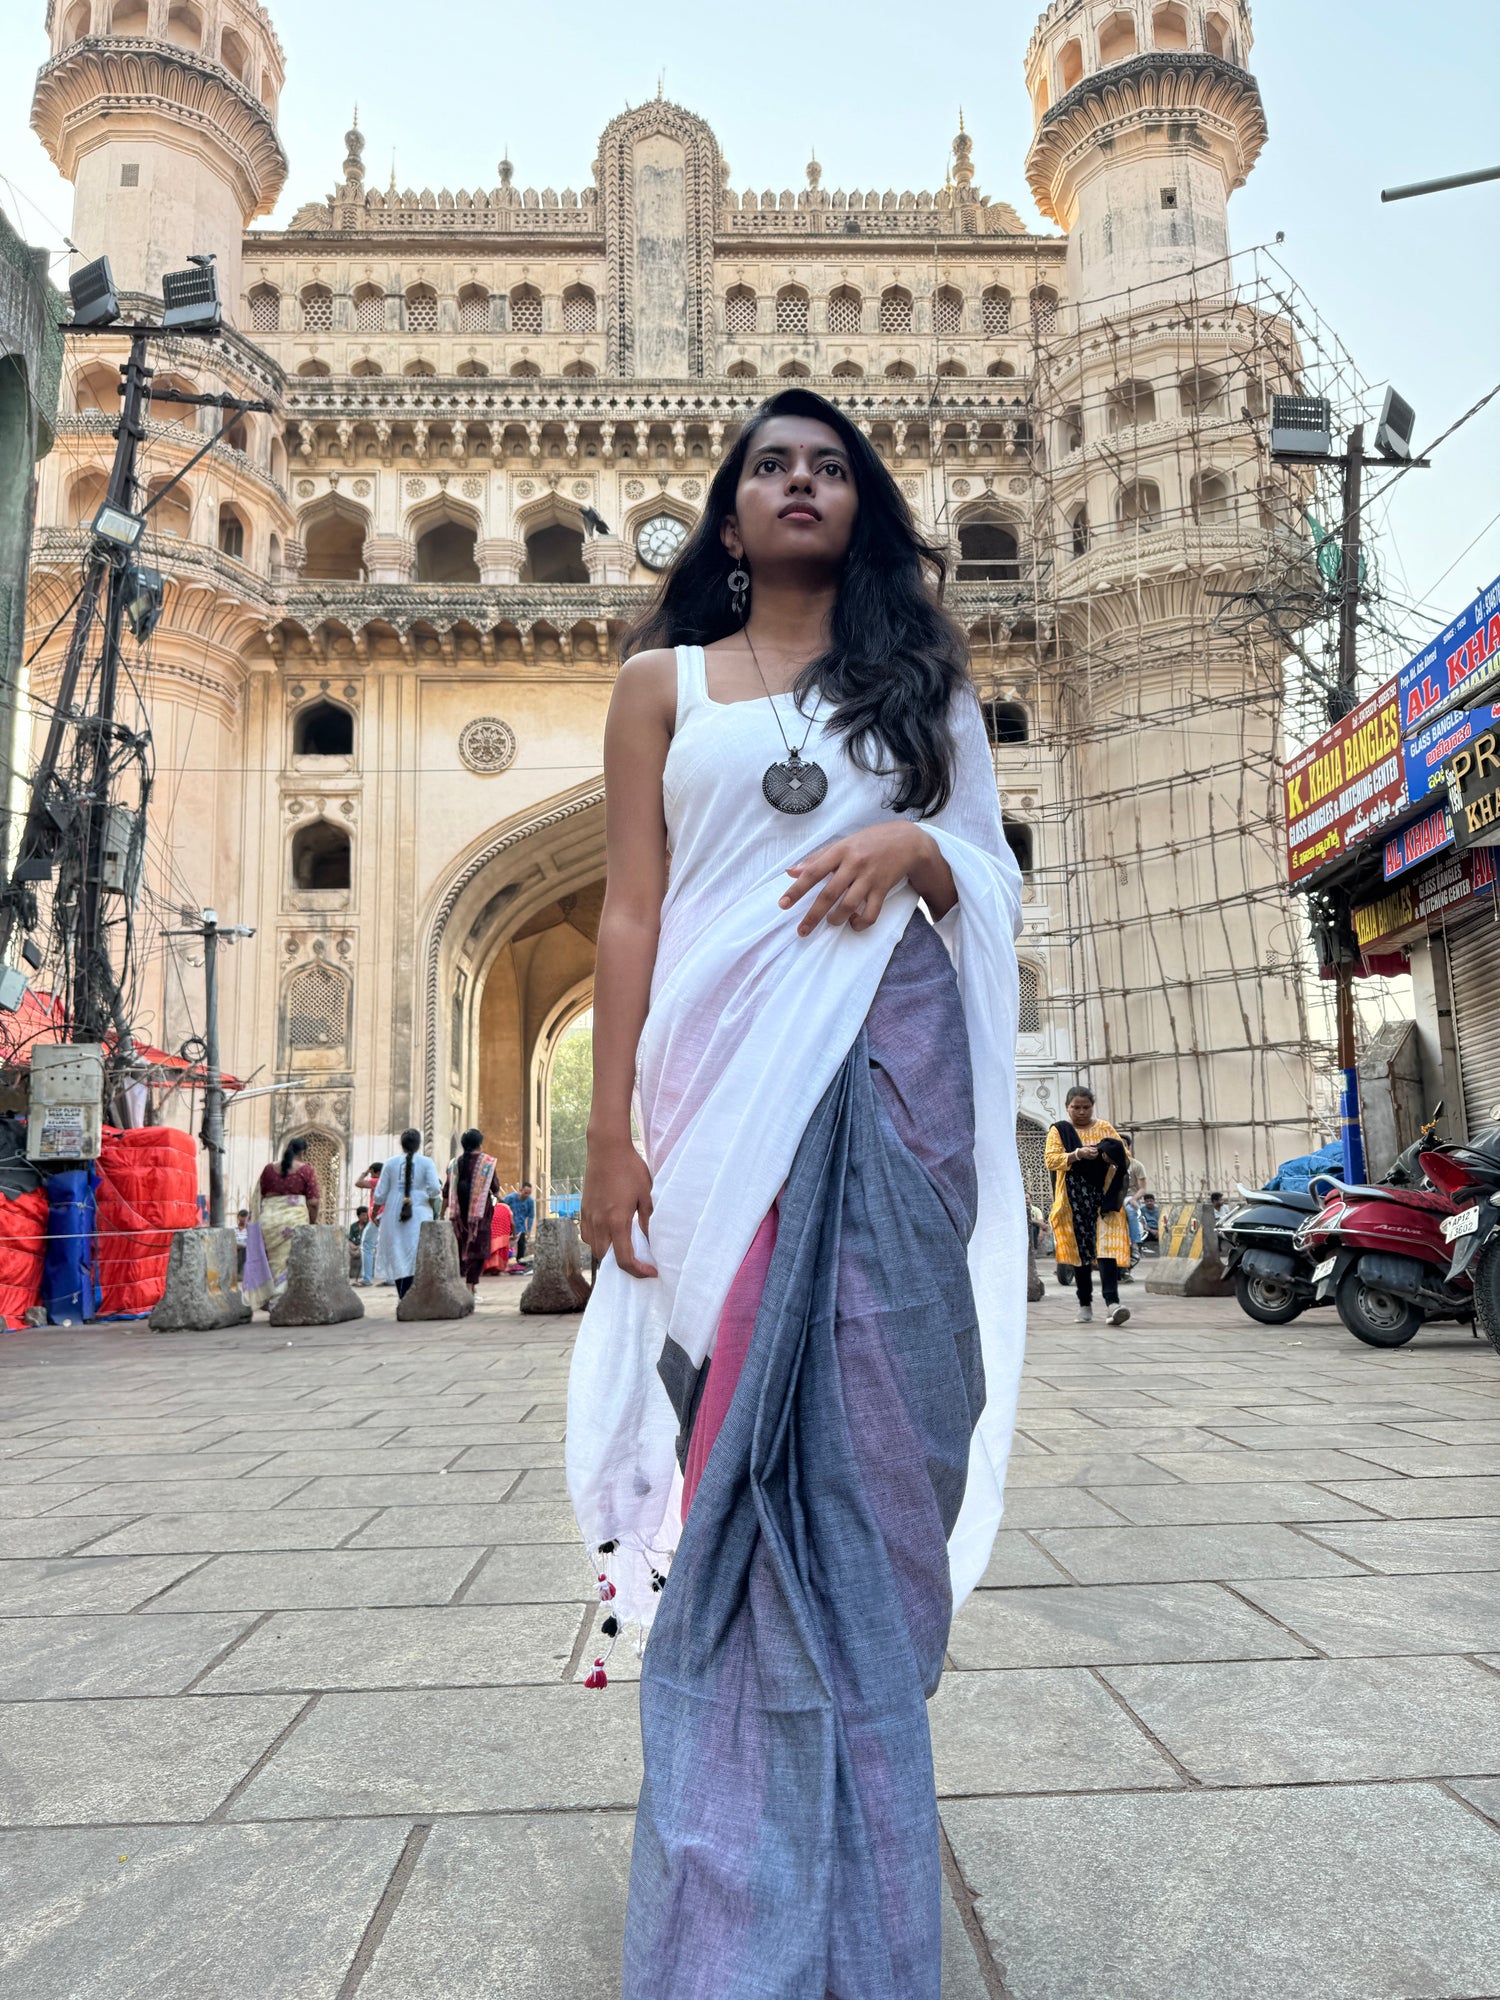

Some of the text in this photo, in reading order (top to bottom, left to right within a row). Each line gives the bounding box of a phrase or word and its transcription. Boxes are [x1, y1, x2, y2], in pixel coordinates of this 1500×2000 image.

[1407, 674, 1441, 726] AL
[1308, 745, 1343, 805] KHAJA
[1344, 703, 1399, 781] BANGLES
[1410, 737, 1431, 758] GLASS
[1431, 709, 1464, 742] BANGLES
[1289, 756, 1399, 848] GLASS BANGLES & MATCHING CENTER
[1386, 838, 1402, 876] AL
[1404, 809, 1447, 865] KHAJA
[1355, 884, 1413, 945] KHAJA BANGLES
[1414, 907, 1420, 920] &
[1448, 878, 1471, 904] CENTER
[1418, 877, 1437, 900] GLASS
[1374, 1224, 1423, 1235] Activa
